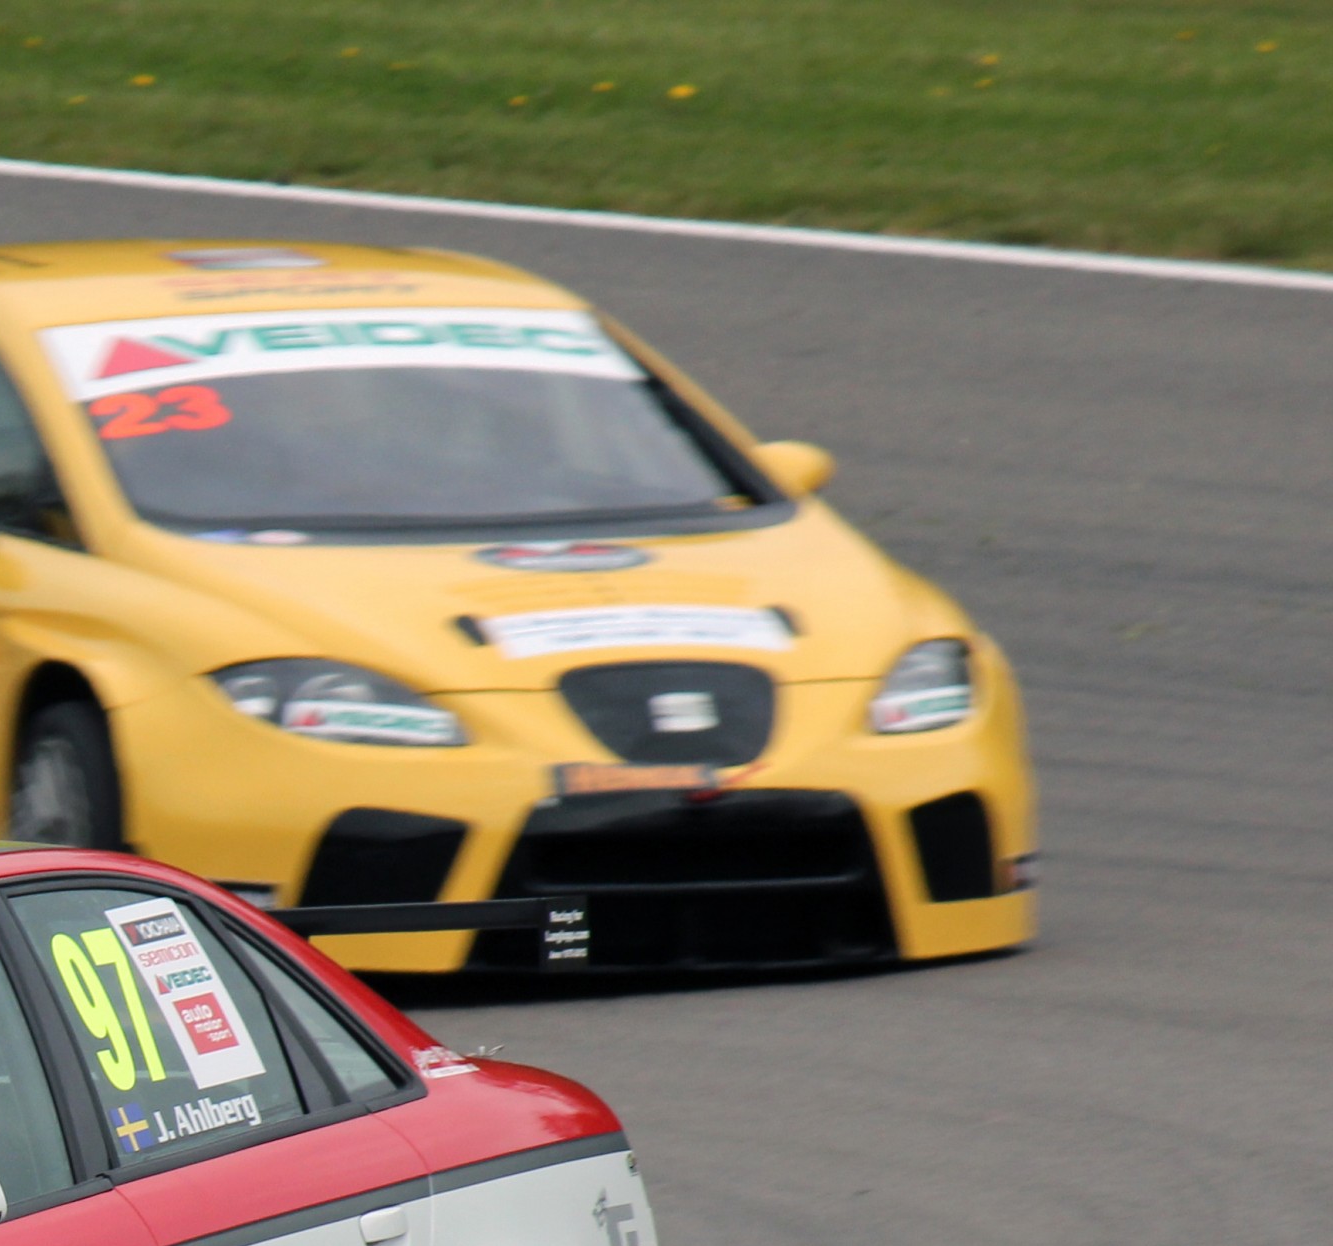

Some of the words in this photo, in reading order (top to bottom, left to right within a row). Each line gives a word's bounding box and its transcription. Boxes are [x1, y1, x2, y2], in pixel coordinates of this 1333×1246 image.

[147, 321, 603, 357] VEIDEC
[88, 385, 234, 440] 23
[138, 942, 199, 967] semcon
[161, 965, 214, 990] VEIDEC
[51, 927, 167, 1091] 97
[181, 1003, 214, 1024] auto
[153, 1109, 176, 1144] J.
[175, 1094, 262, 1140] Ahlberg
